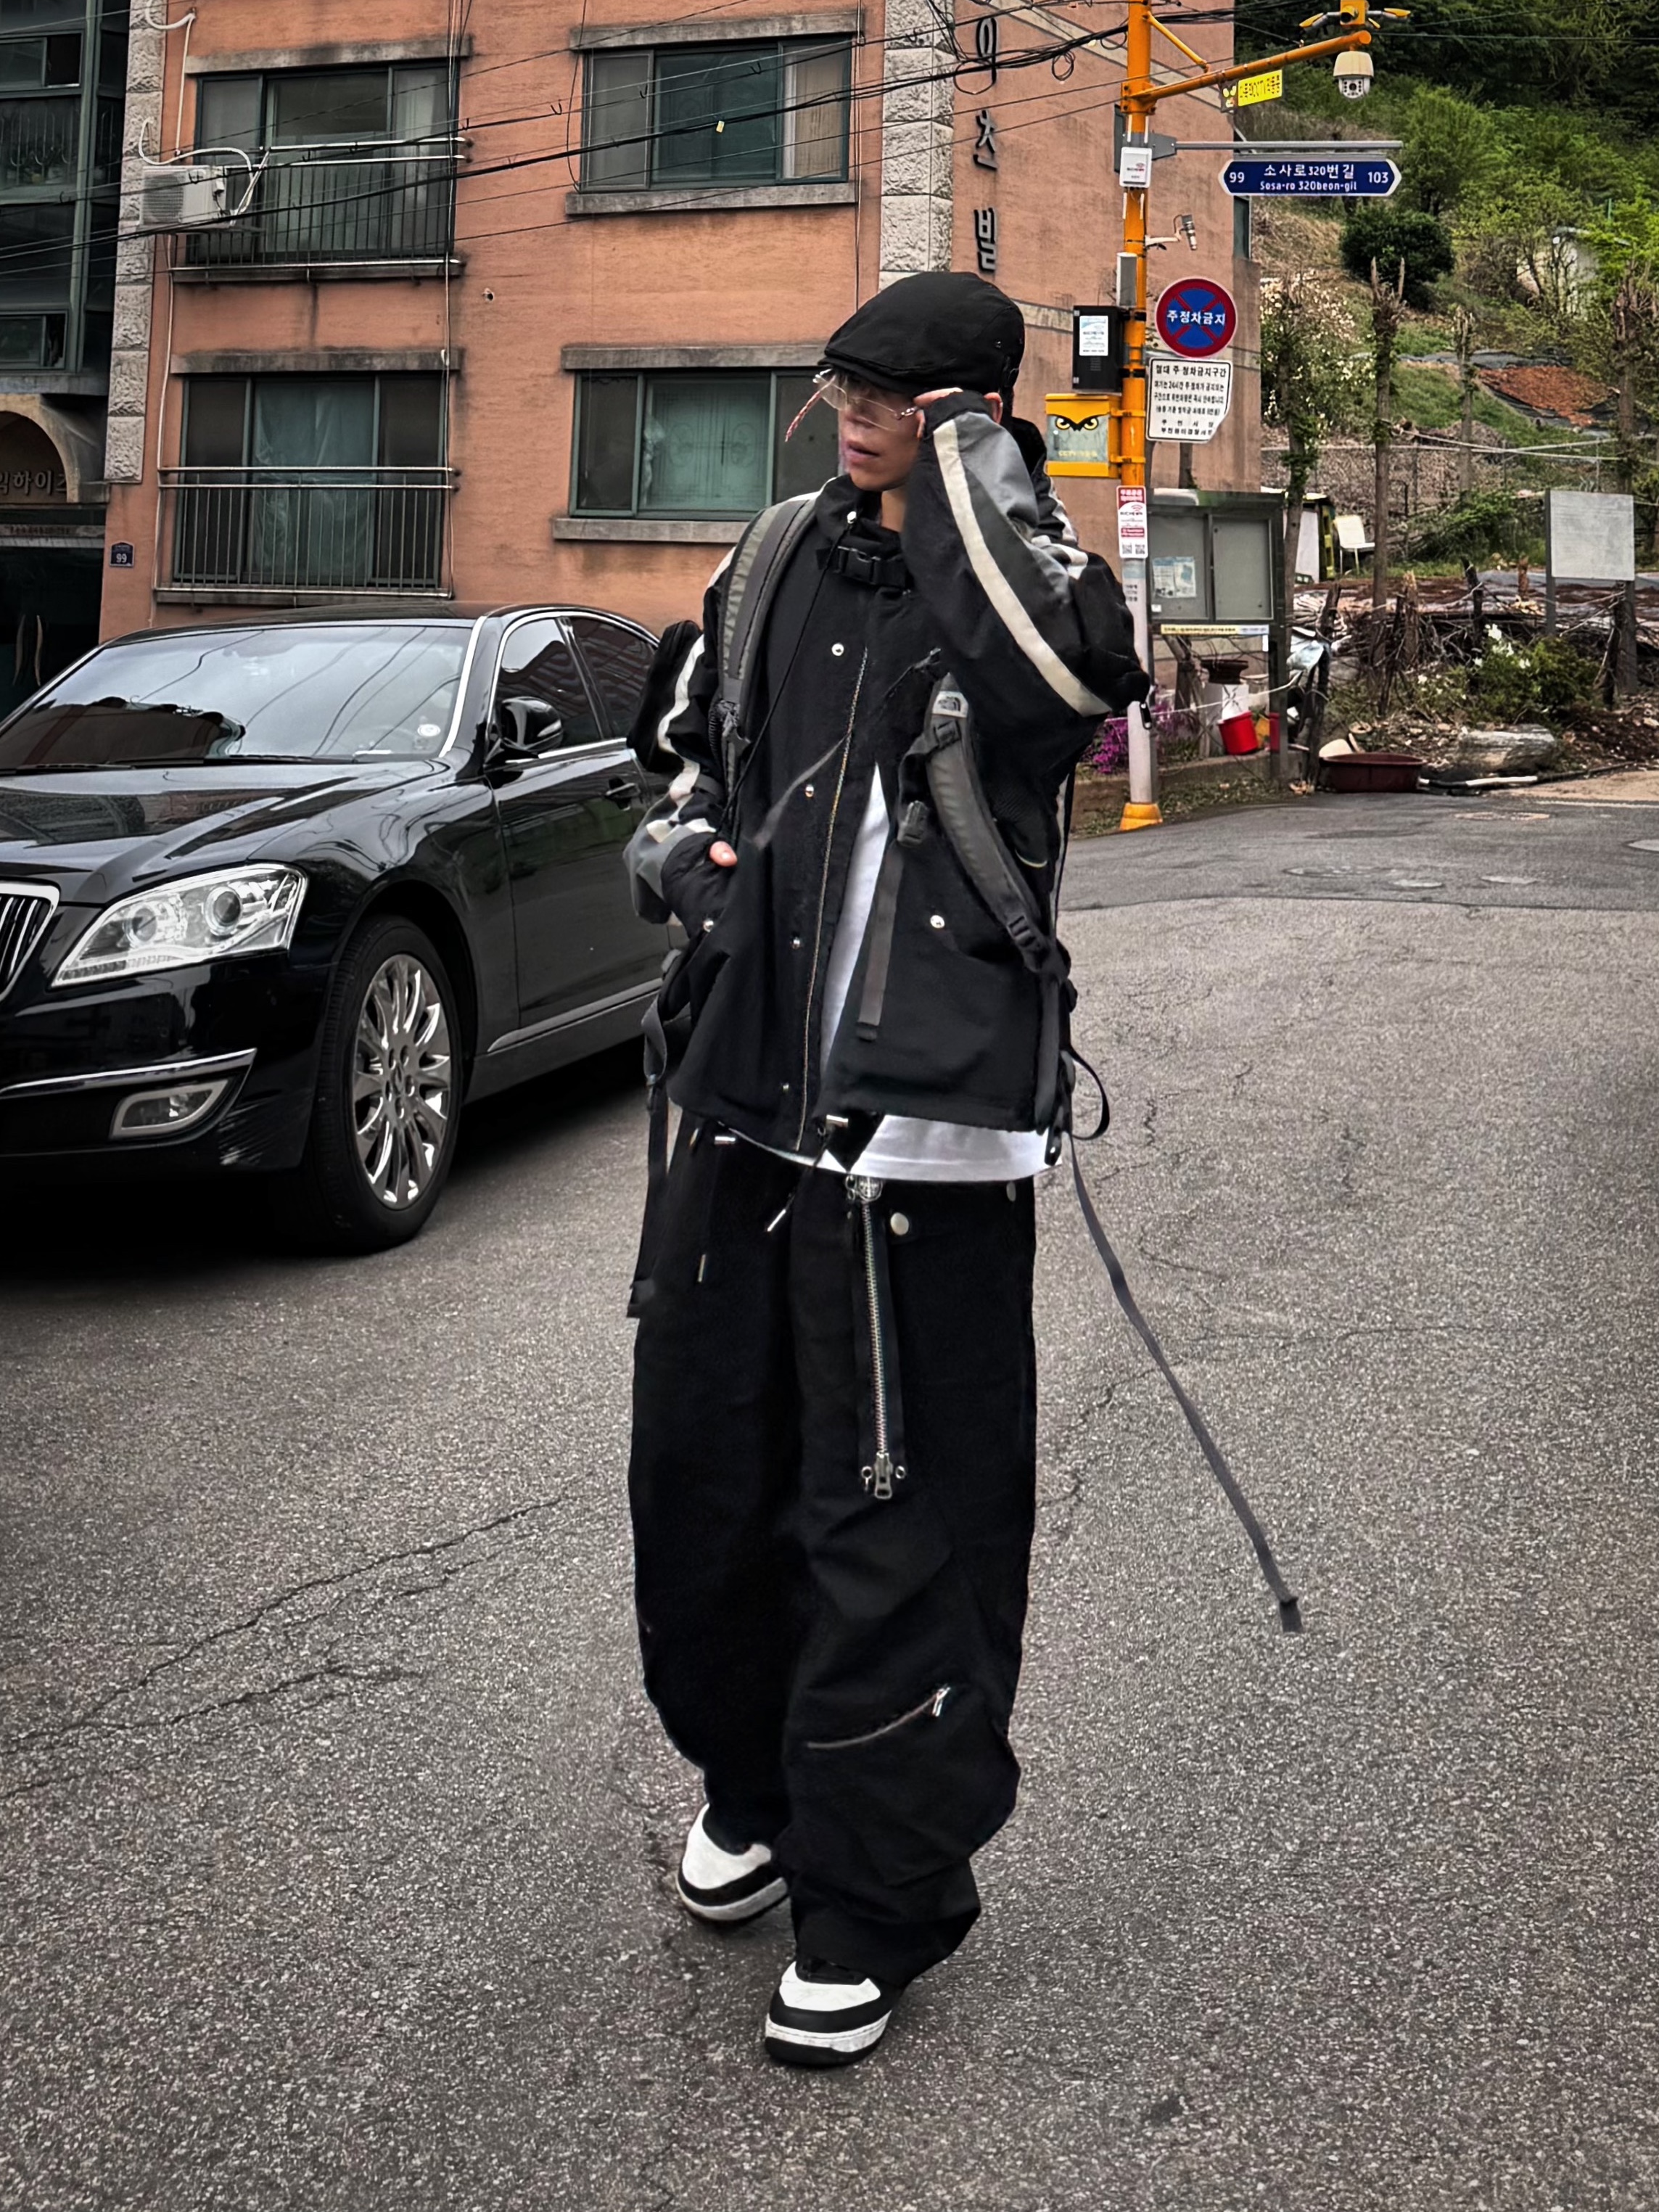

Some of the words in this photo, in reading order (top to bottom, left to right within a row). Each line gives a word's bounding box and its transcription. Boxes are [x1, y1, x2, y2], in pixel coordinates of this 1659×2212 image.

[1263, 164, 1354, 179] 소사로320번길
[1229, 172, 1245, 183] 99
[1367, 172, 1388, 183] 103
[1259, 181, 1295, 190] Sosa-ro
[1298, 181, 1357, 192] 320beon-gil
[1166, 310, 1225, 326] 주정차금지
[115, 553, 128, 563] 99
